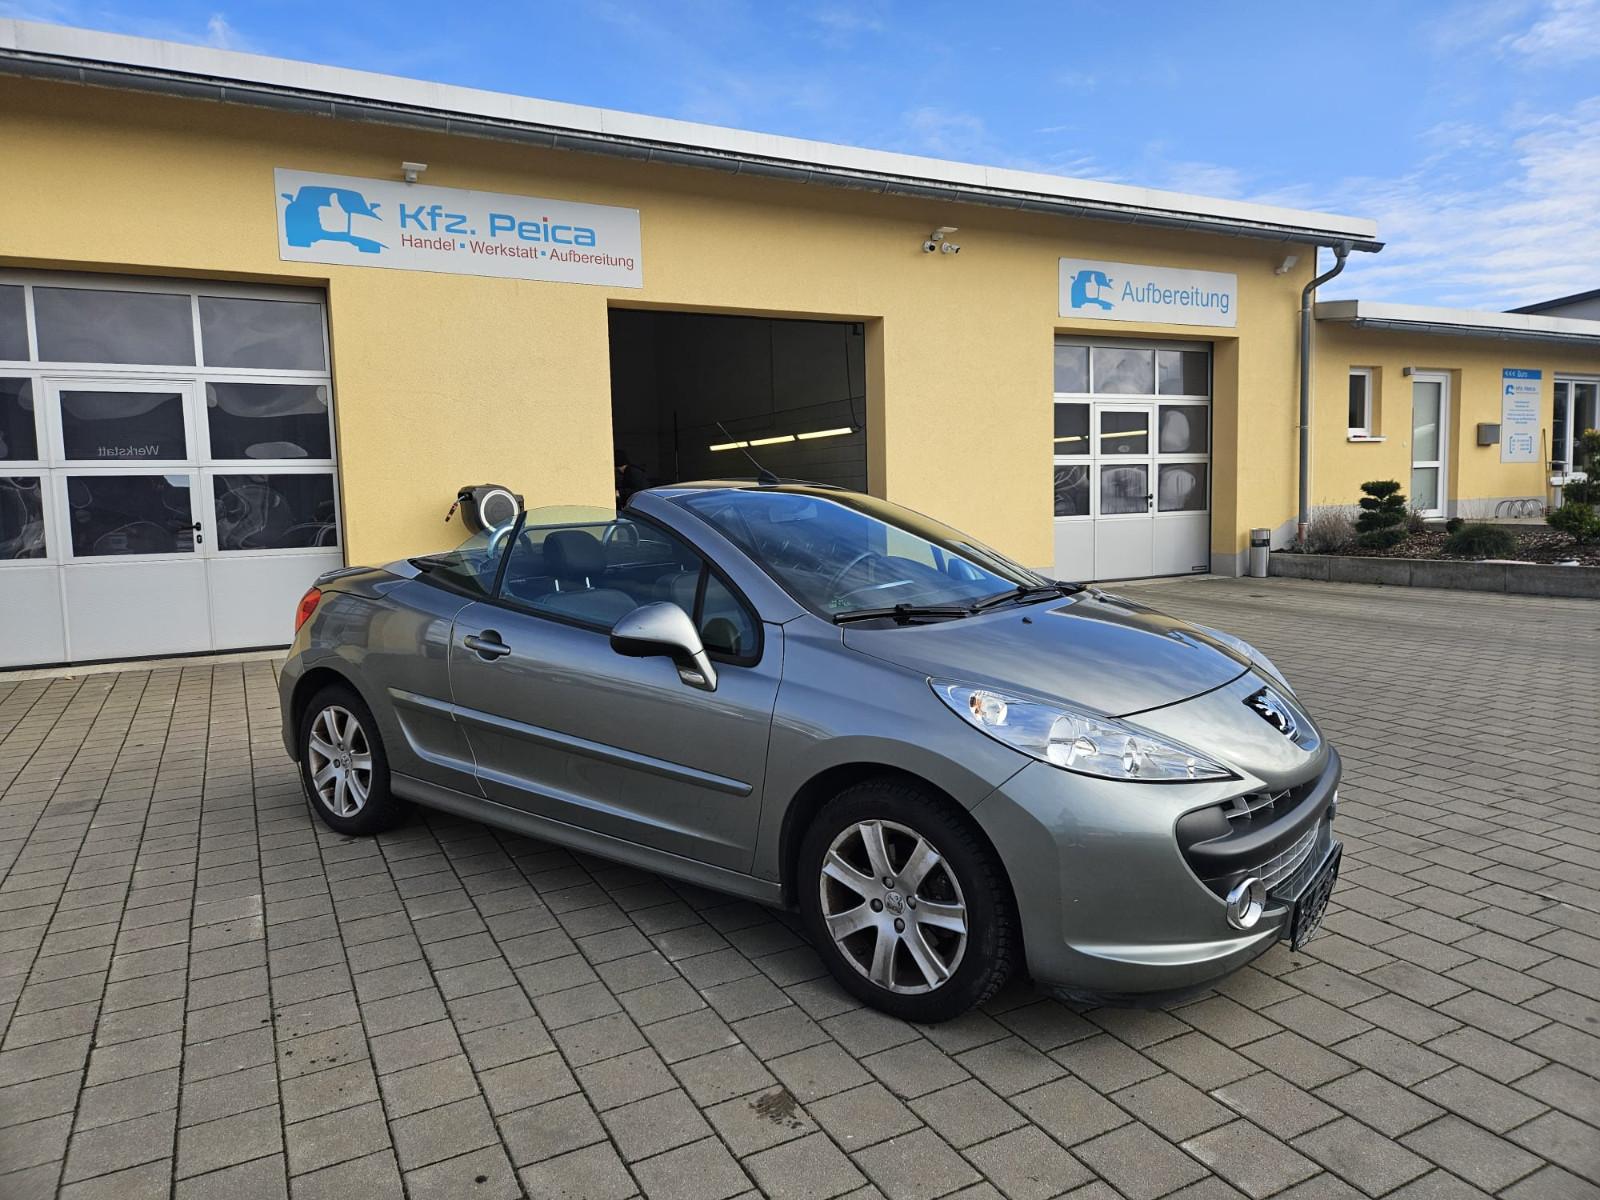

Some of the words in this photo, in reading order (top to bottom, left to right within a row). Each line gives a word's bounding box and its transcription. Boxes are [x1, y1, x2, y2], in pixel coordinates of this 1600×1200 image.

[400, 203, 476, 235] Kfz.
[489, 213, 596, 247] Peica
[401, 234, 455, 251] Handel
[469, 240, 538, 259] Werkstatt
[550, 248, 634, 271] Aufbereitung
[1121, 281, 1229, 313] Aufbereitung
